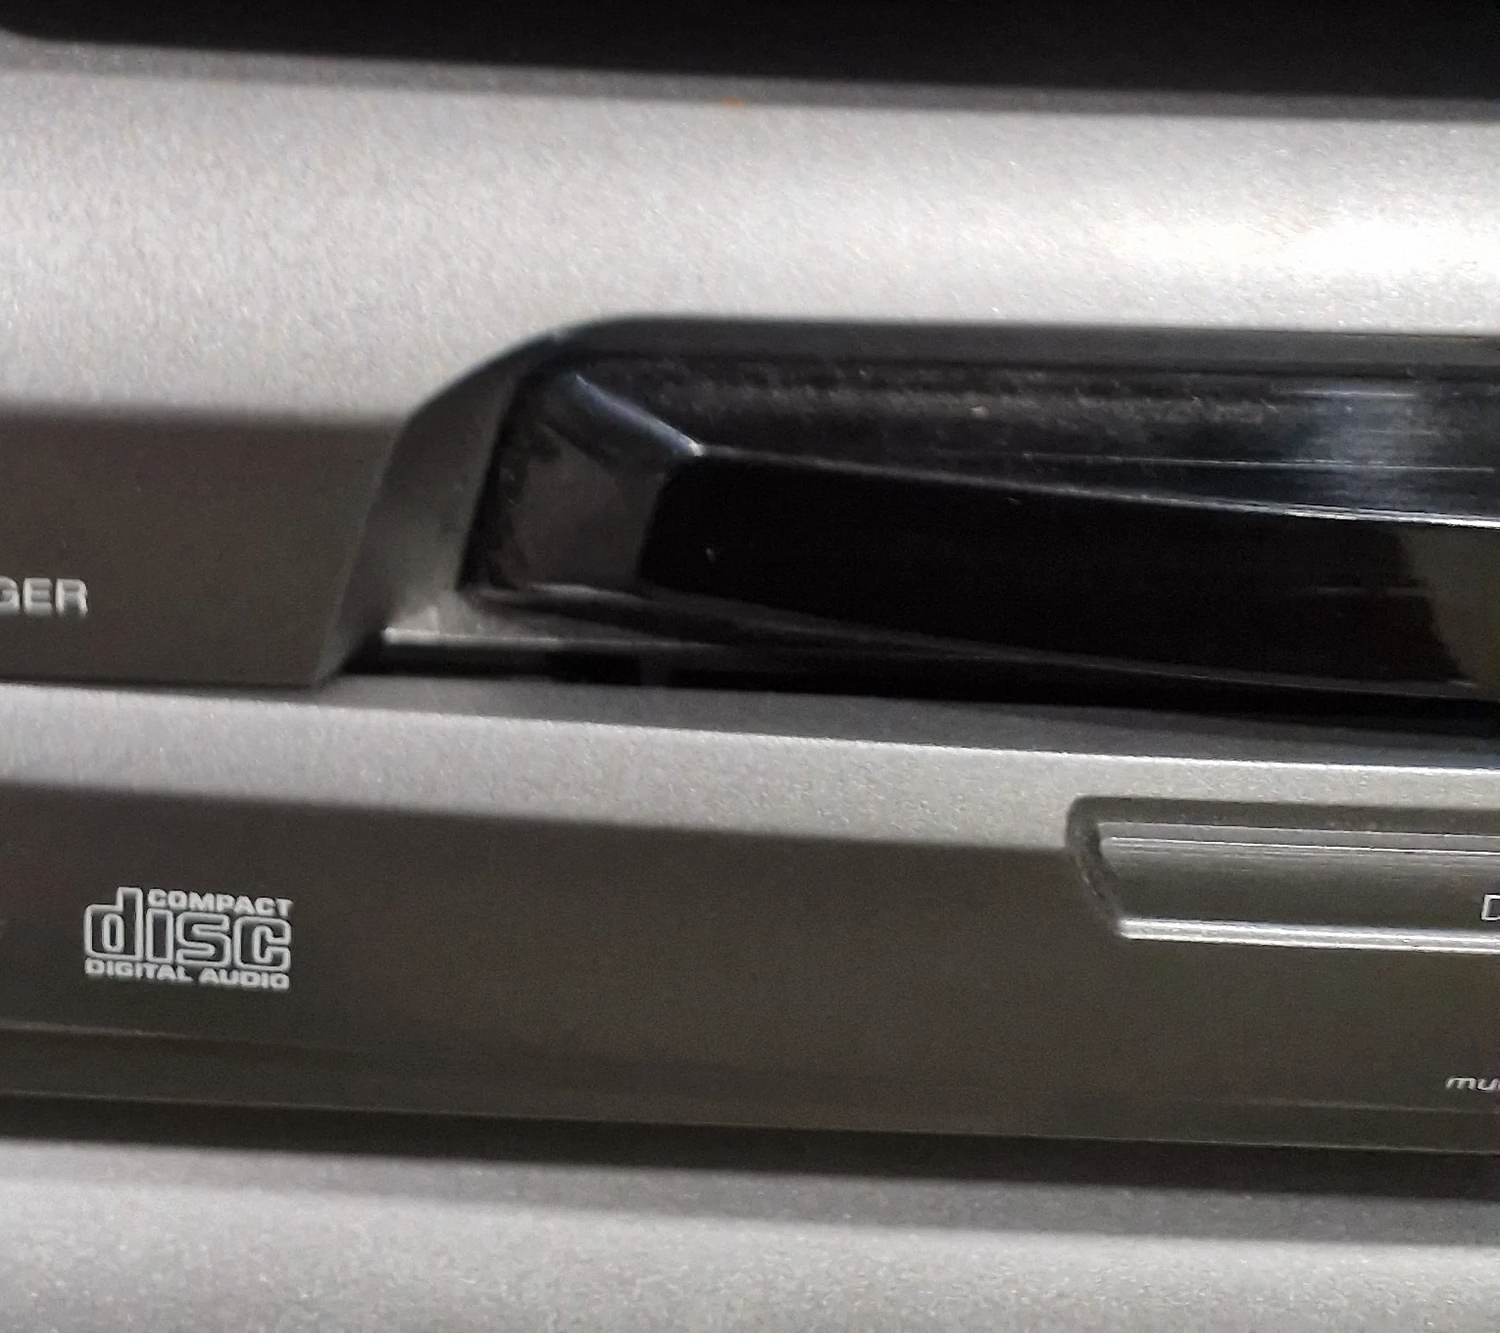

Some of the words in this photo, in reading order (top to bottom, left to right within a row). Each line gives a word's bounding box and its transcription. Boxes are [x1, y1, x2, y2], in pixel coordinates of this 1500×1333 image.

[147, 888, 294, 918] COMPACT
[85, 957, 194, 982] DIGITAL
[199, 967, 291, 992] AUDIO
